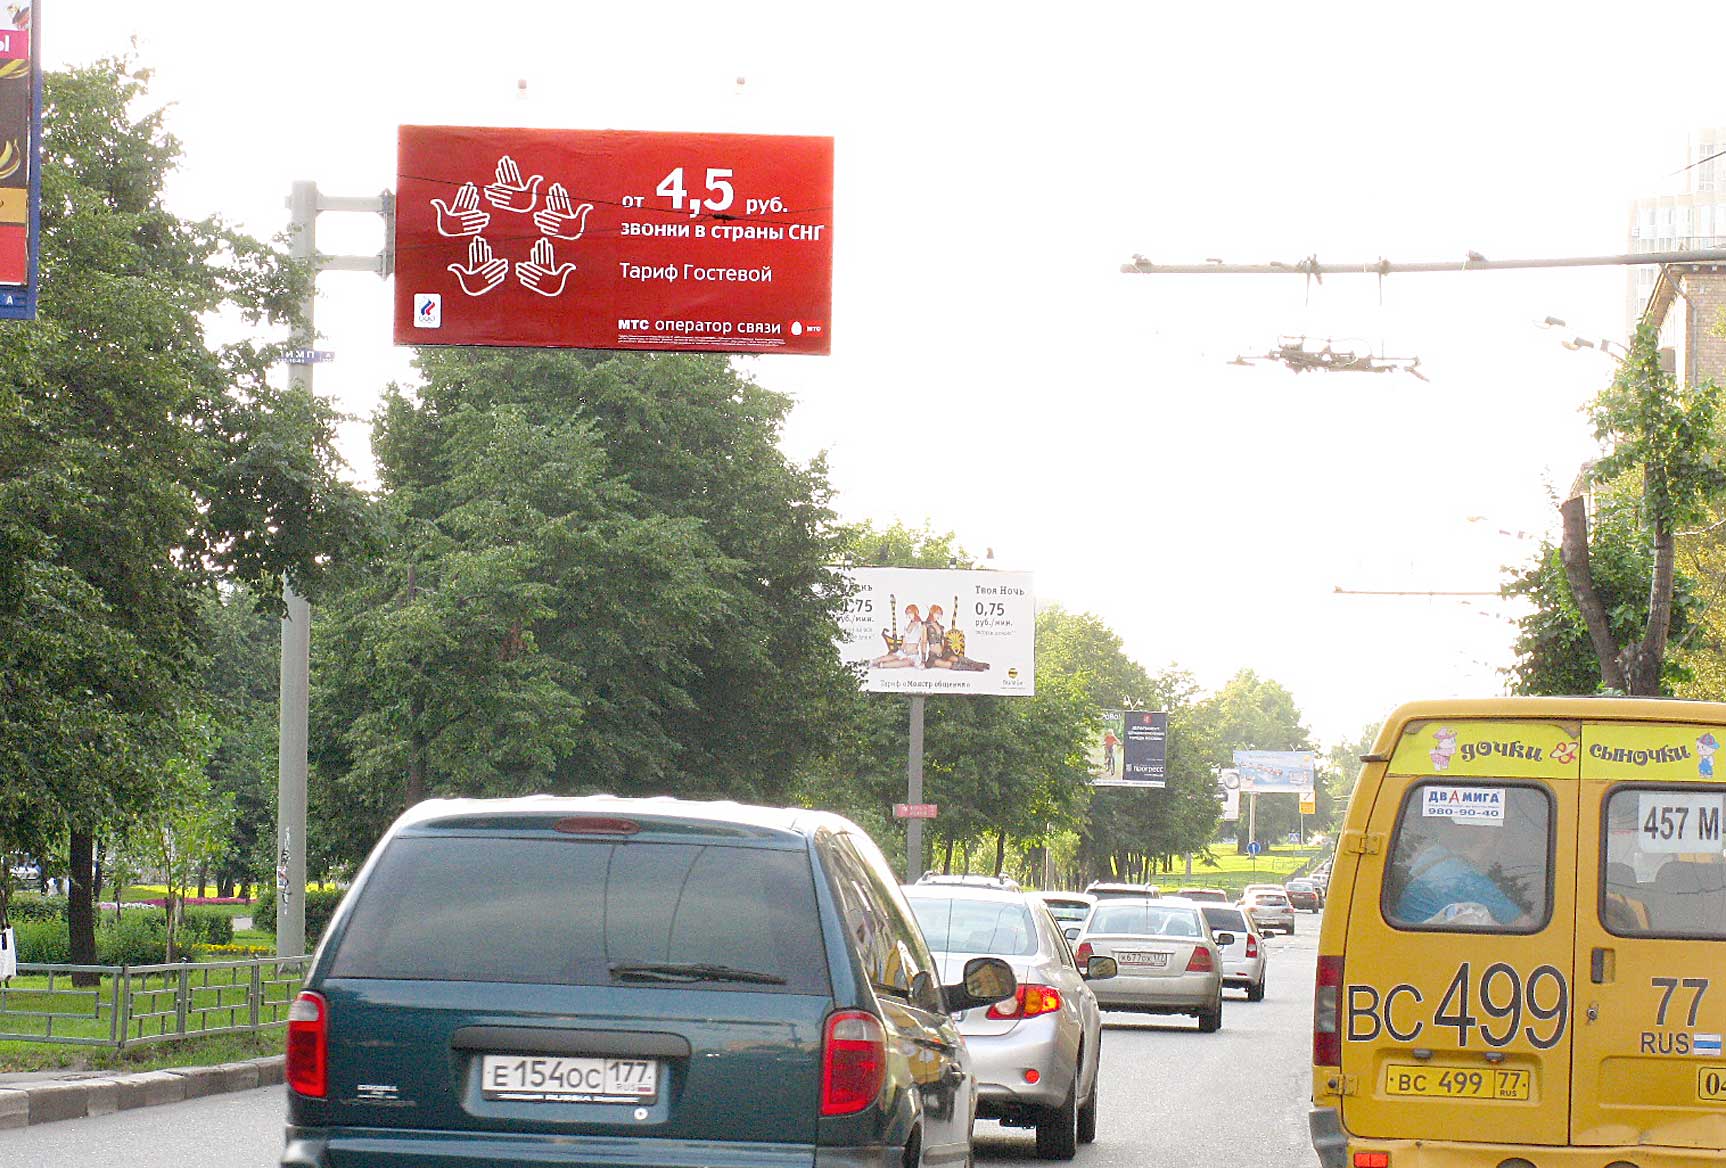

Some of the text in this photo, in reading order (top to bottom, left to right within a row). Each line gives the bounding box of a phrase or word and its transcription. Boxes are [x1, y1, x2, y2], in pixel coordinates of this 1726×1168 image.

[621, 167, 789, 218] от 4,5 руб.
[621, 222, 825, 242] звонки в страны СНГ
[620, 262, 772, 283] Тариф Гостевой
[654, 319, 732, 334] оператор
[736, 322, 781, 334] связи
[975, 601, 1005, 617] 0,75
[1460, 739, 1543, 763] дочки
[1588, 740, 1691, 767] сыночки
[1428, 807, 1499, 818] 980-90-40
[1643, 807, 1720, 841] 457 М
[1433, 961, 1570, 1050] 499
[1650, 976, 1709, 1028] 77
[1640, 1031, 1689, 1055] RUS
[609, 1061, 647, 1084] 177
[1439, 1070, 1483, 1095] 499
[1497, 1071, 1521, 1090] 77
[616, 1083, 637, 1092] RUS
[1499, 1089, 1518, 1097] RUS
